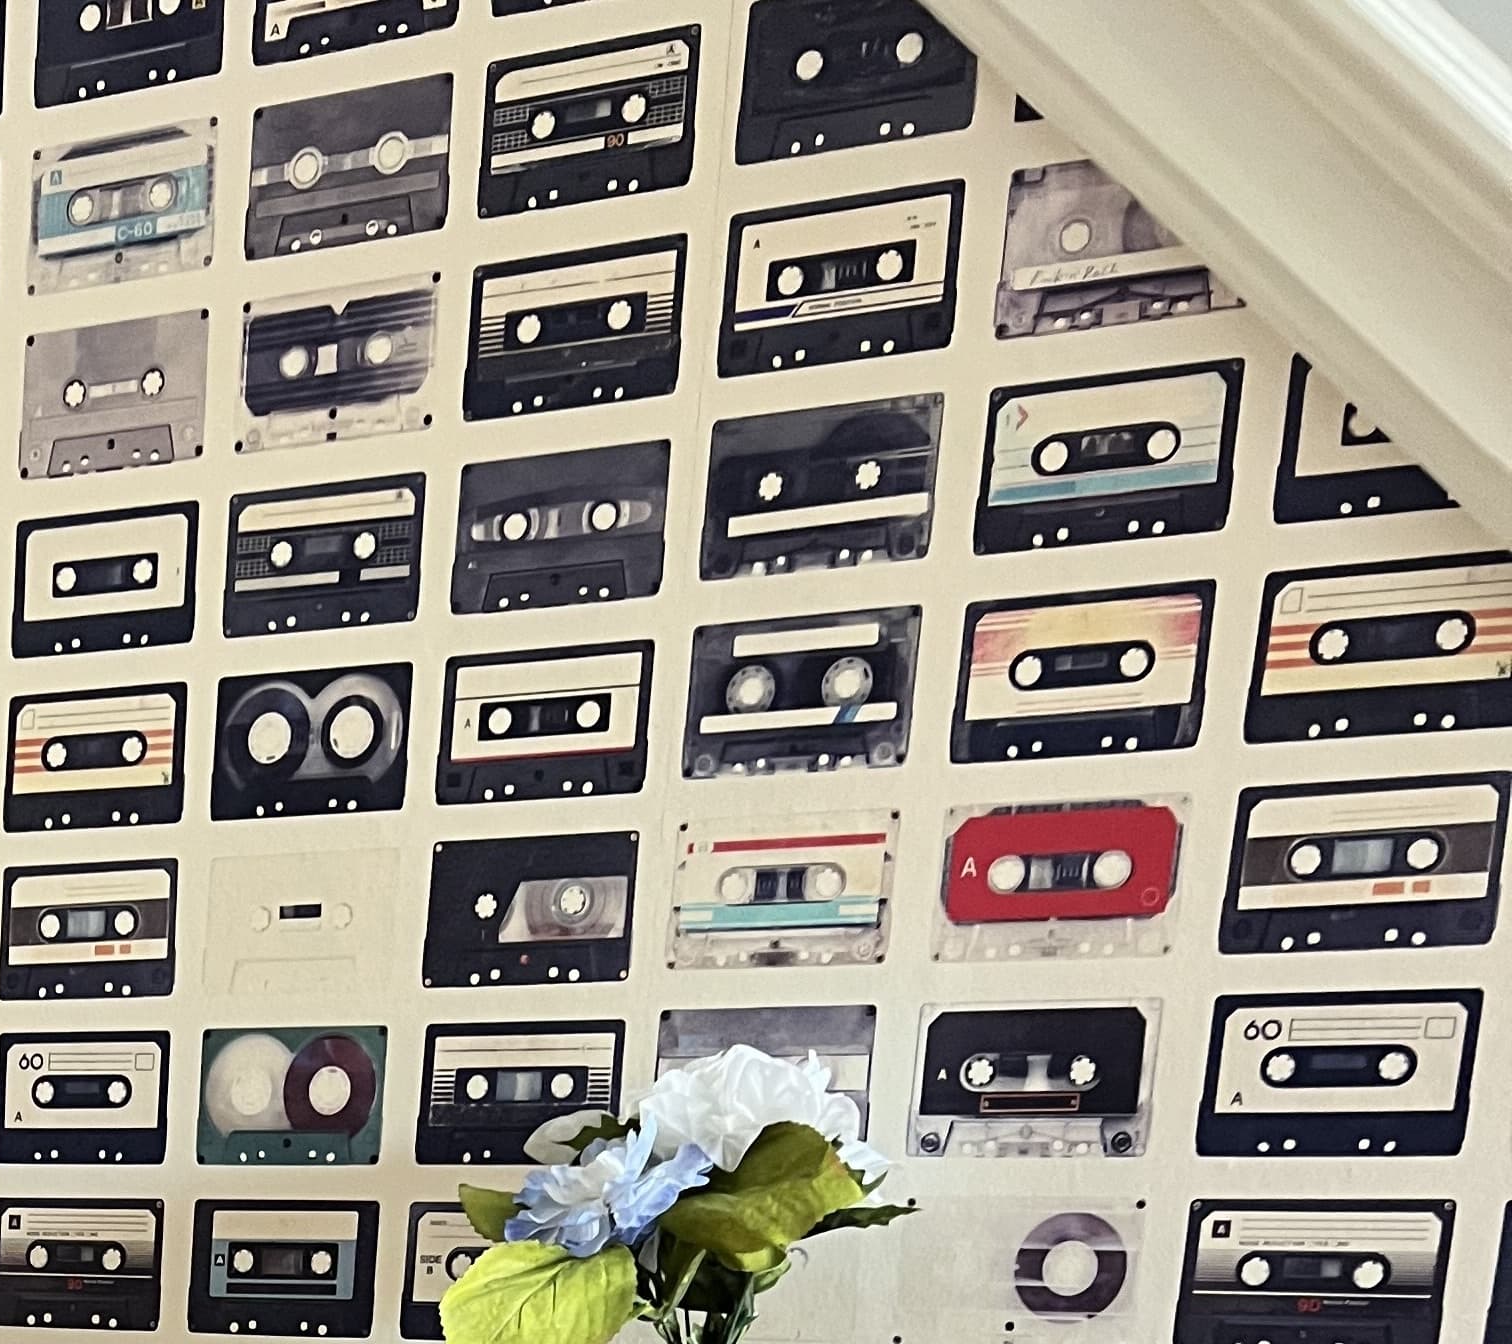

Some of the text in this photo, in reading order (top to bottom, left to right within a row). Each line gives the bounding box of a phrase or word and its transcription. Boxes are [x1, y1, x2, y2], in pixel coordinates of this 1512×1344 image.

[270, 23, 280, 37] A
[607, 133, 625, 148] 90
[118, 221, 153, 241] C-60
[753, 238, 761, 250] A
[464, 718, 471, 729] A
[960, 856, 977, 879] A
[1243, 1019, 1283, 1040] 60
[19, 1053, 44, 1070] 60
[937, 1068, 947, 1081] A
[1230, 1091, 1243, 1106] A
[14, 1111, 23, 1122] A
[420, 1255, 442, 1264] SIDE
[1297, 1299, 1320, 1312] 90
